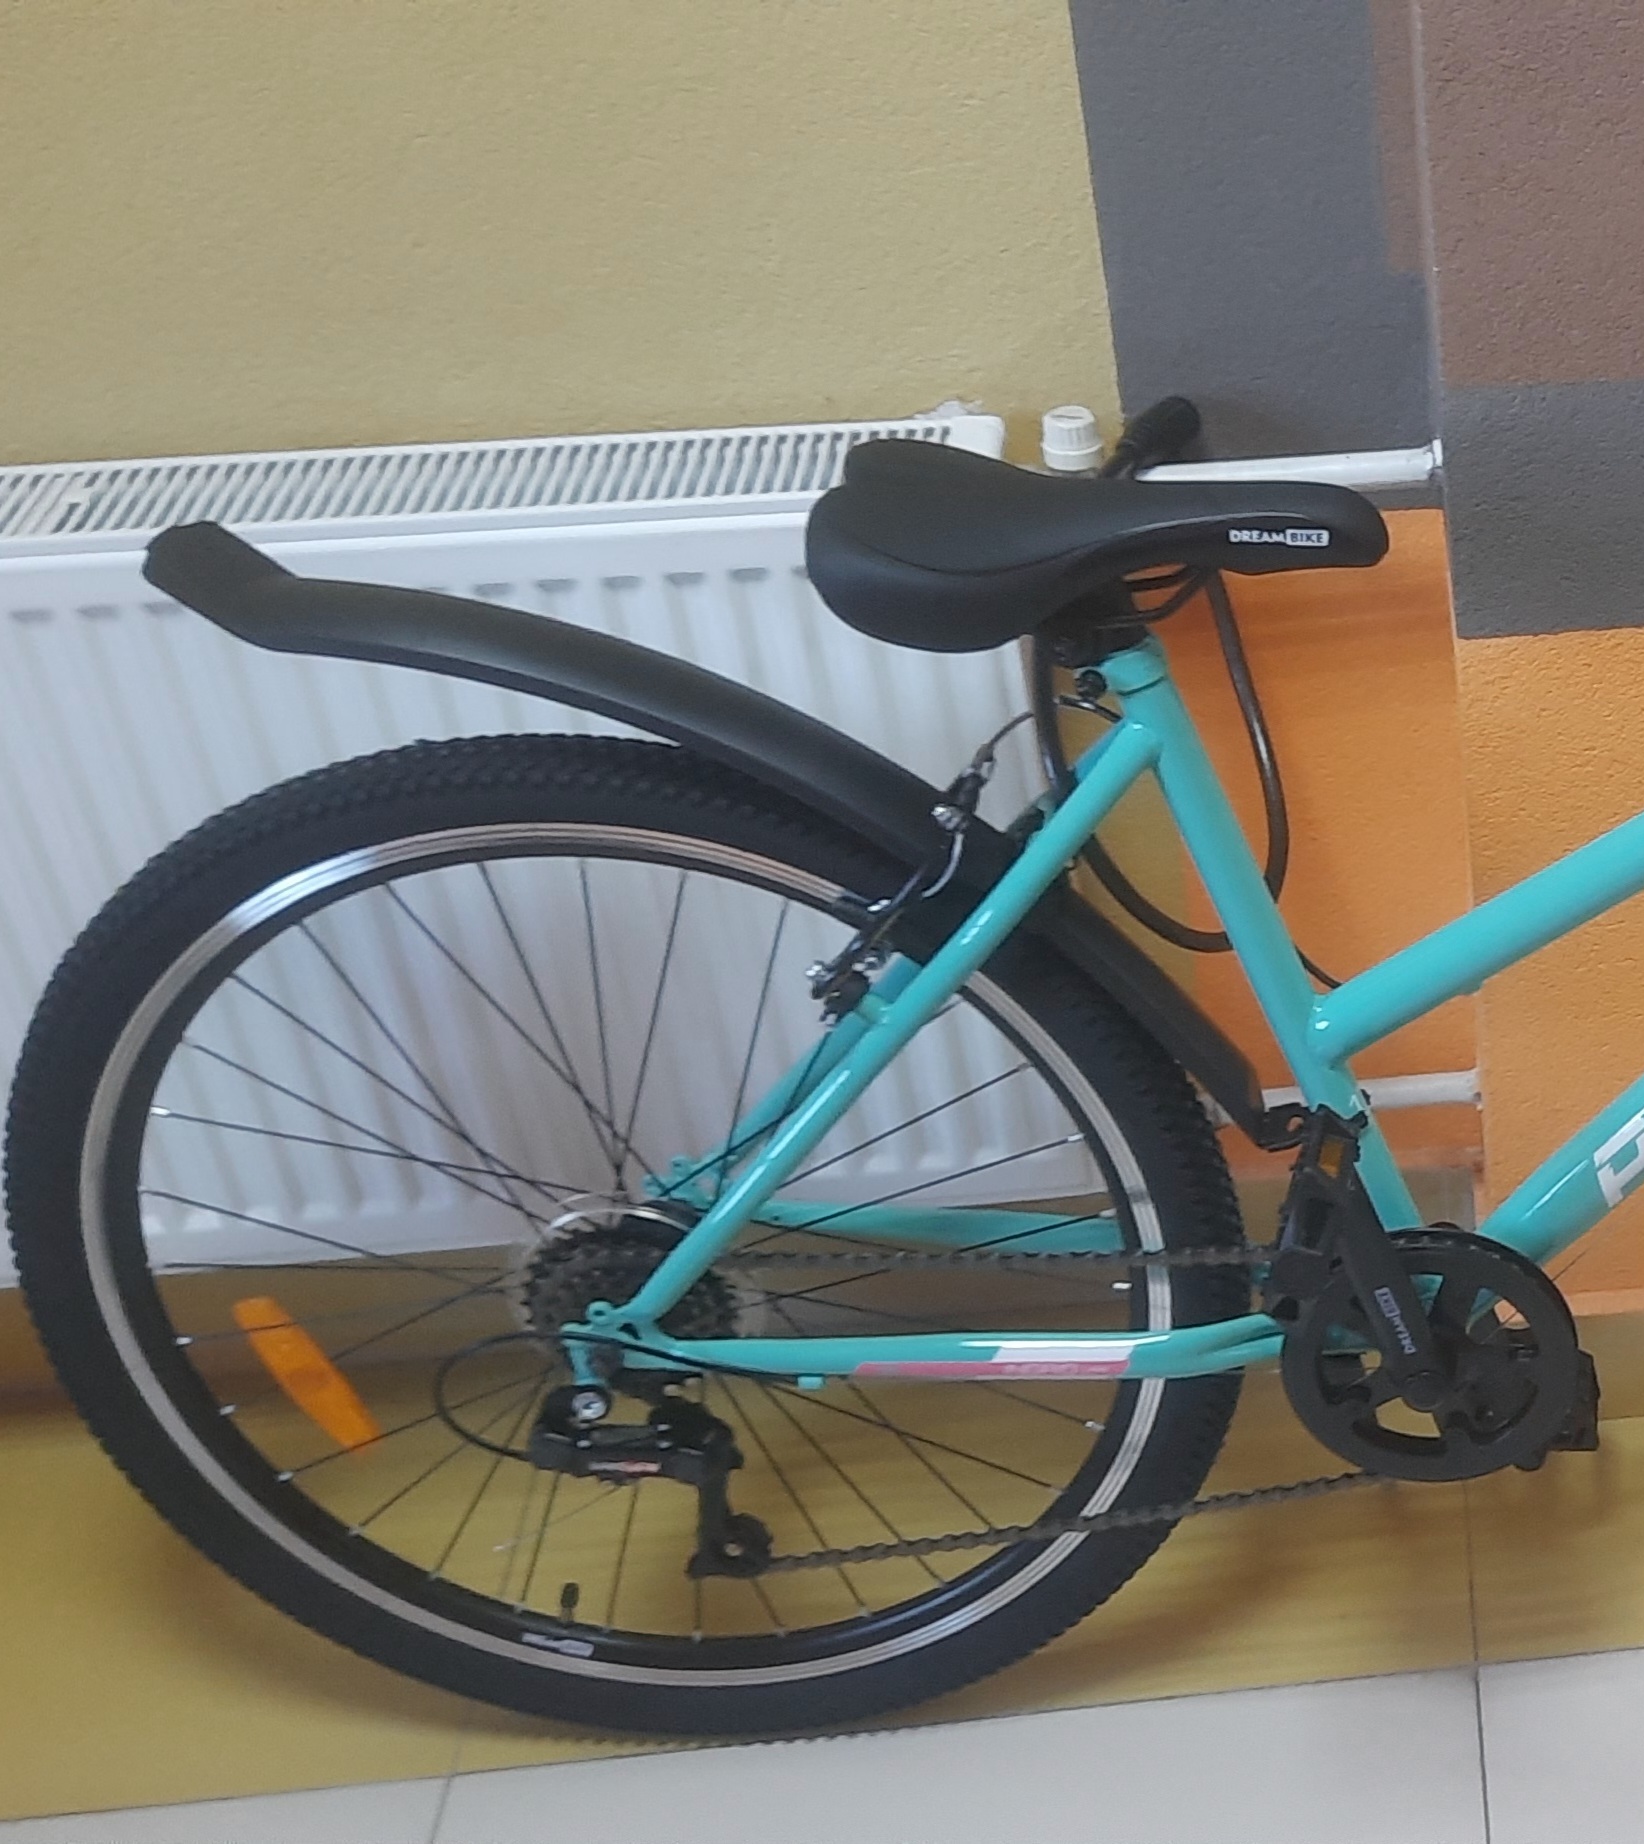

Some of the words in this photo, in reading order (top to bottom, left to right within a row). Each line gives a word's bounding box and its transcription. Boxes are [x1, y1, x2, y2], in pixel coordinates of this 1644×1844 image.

[1228, 529, 1287, 544] DREAM
[1289, 531, 1325, 544] BIKE
[1391, 1314, 1417, 1355] DREAM
